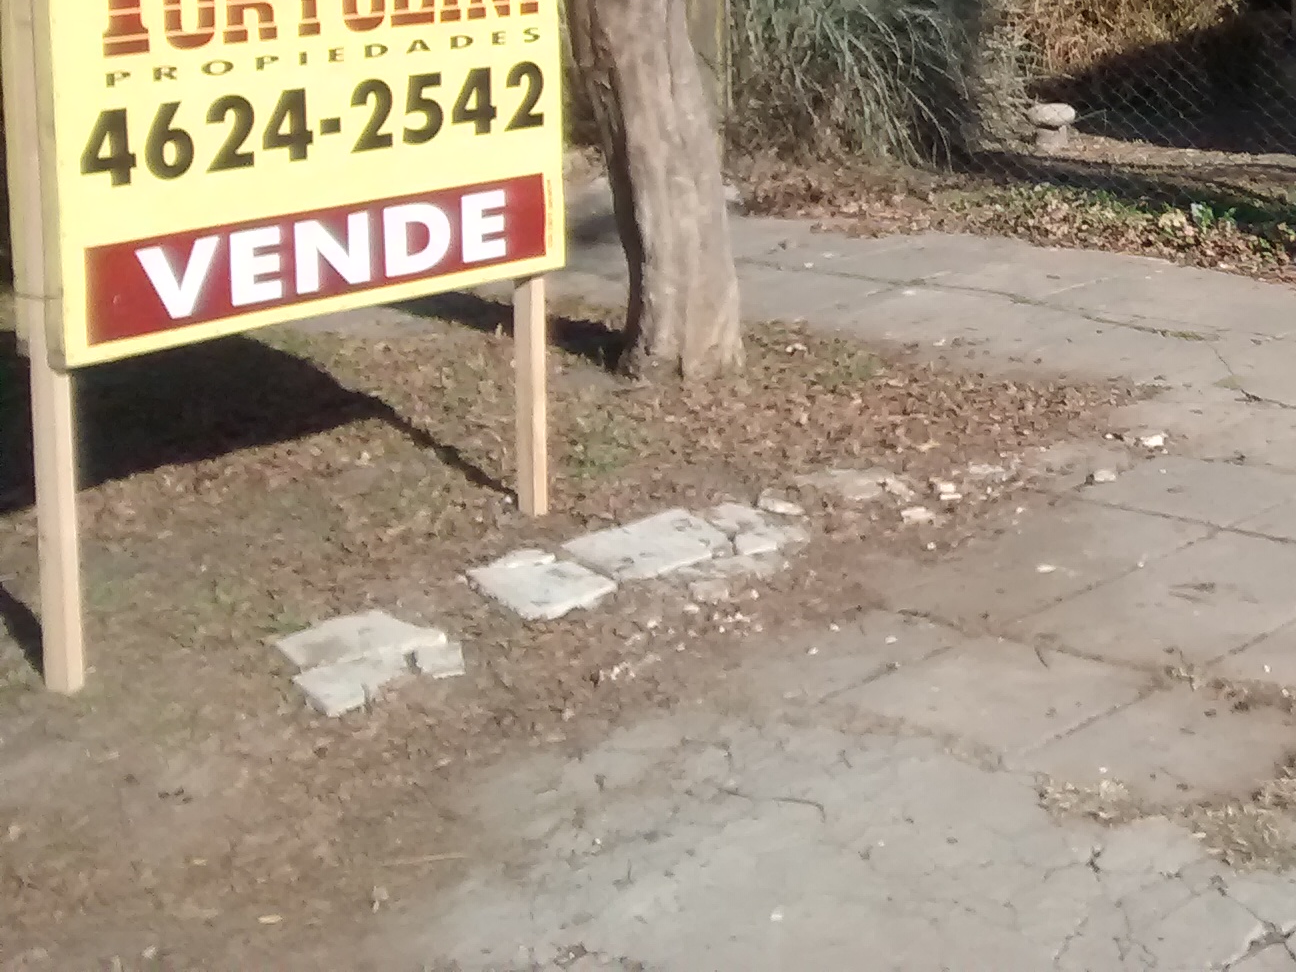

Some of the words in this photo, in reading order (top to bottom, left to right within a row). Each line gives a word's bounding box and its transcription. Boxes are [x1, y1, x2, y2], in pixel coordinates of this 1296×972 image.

[105, 27, 543, 88] PROPIEDADES
[80, 60, 546, 188] 4624-2542
[134, 188, 508, 321] VENDE
